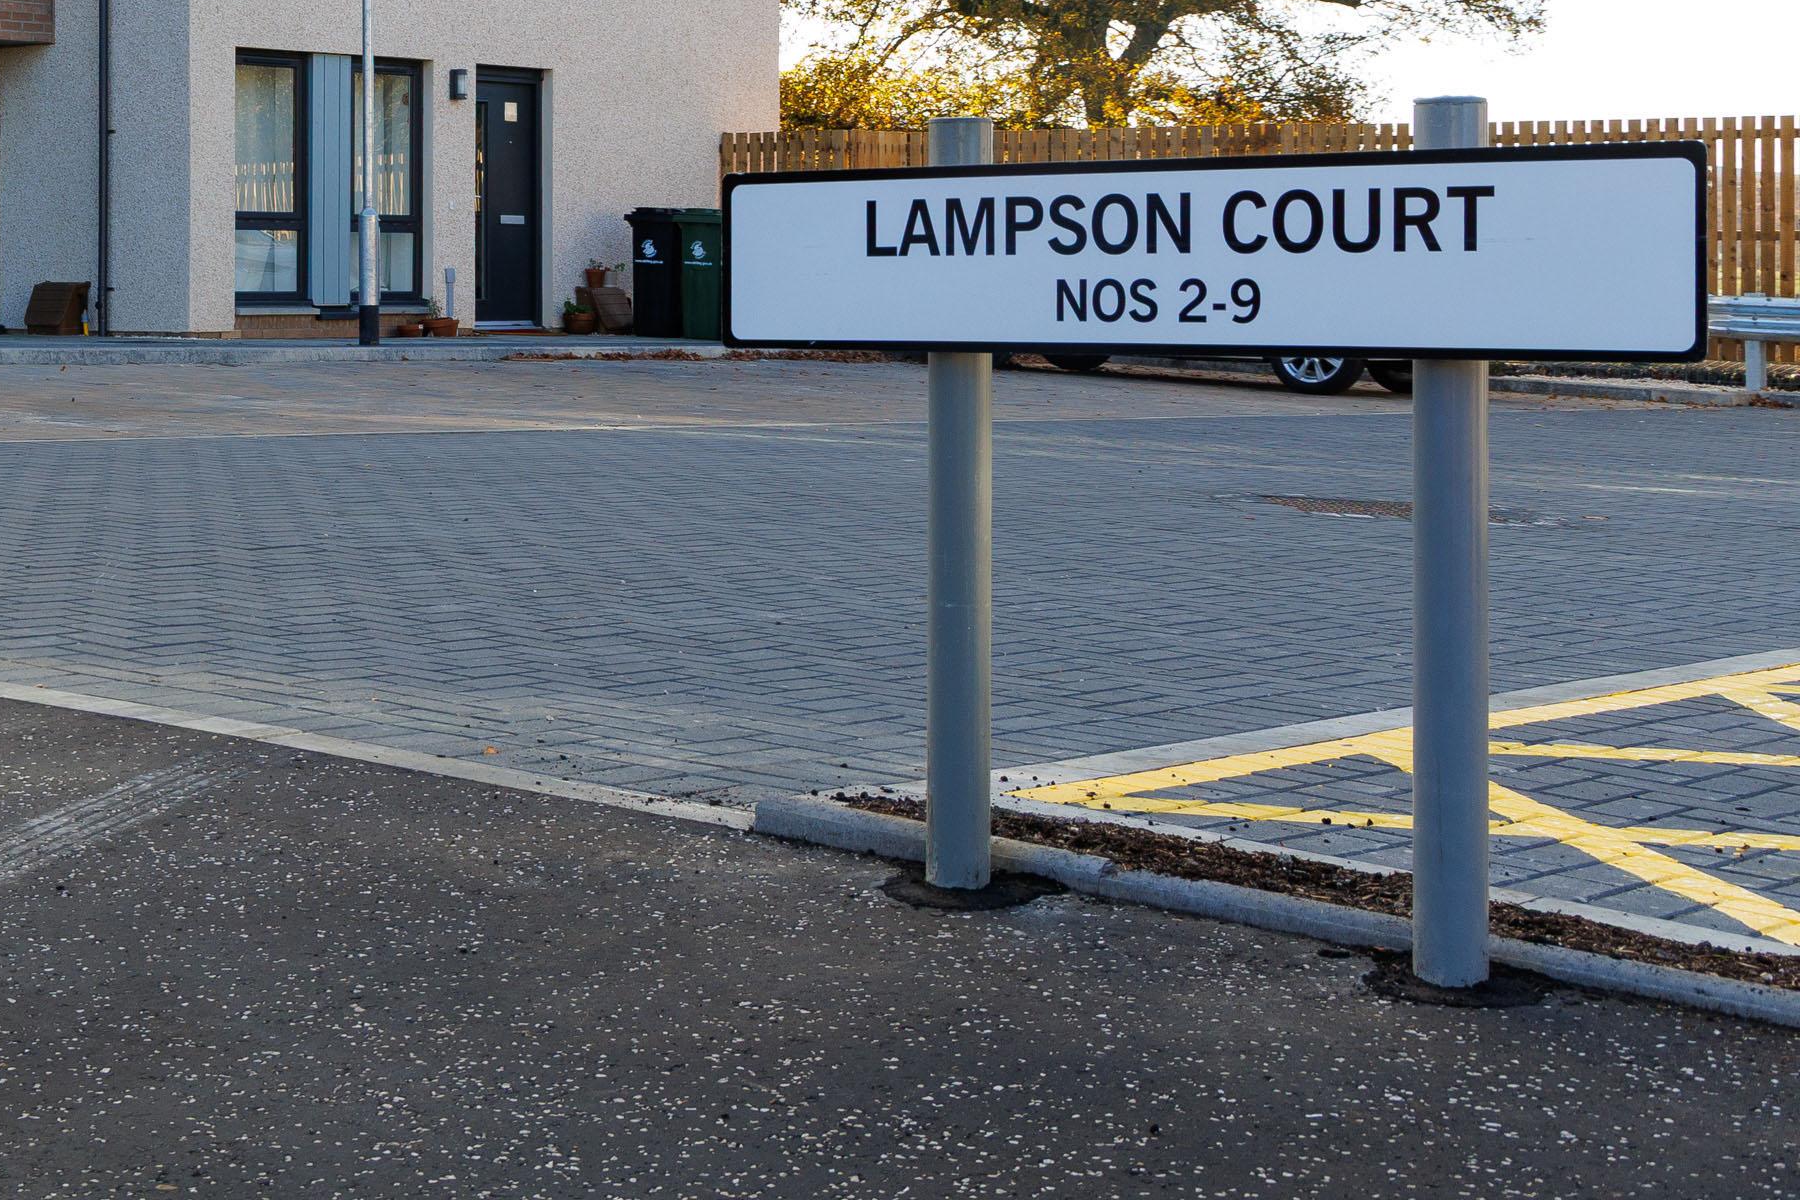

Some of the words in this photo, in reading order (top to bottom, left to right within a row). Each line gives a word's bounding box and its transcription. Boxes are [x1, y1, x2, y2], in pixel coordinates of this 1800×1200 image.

[866, 192, 1191, 257] LAMPSON
[1222, 185, 1495, 254] COURT
[1056, 278, 1159, 323] NOS
[1178, 277, 1261, 324] 2-9
